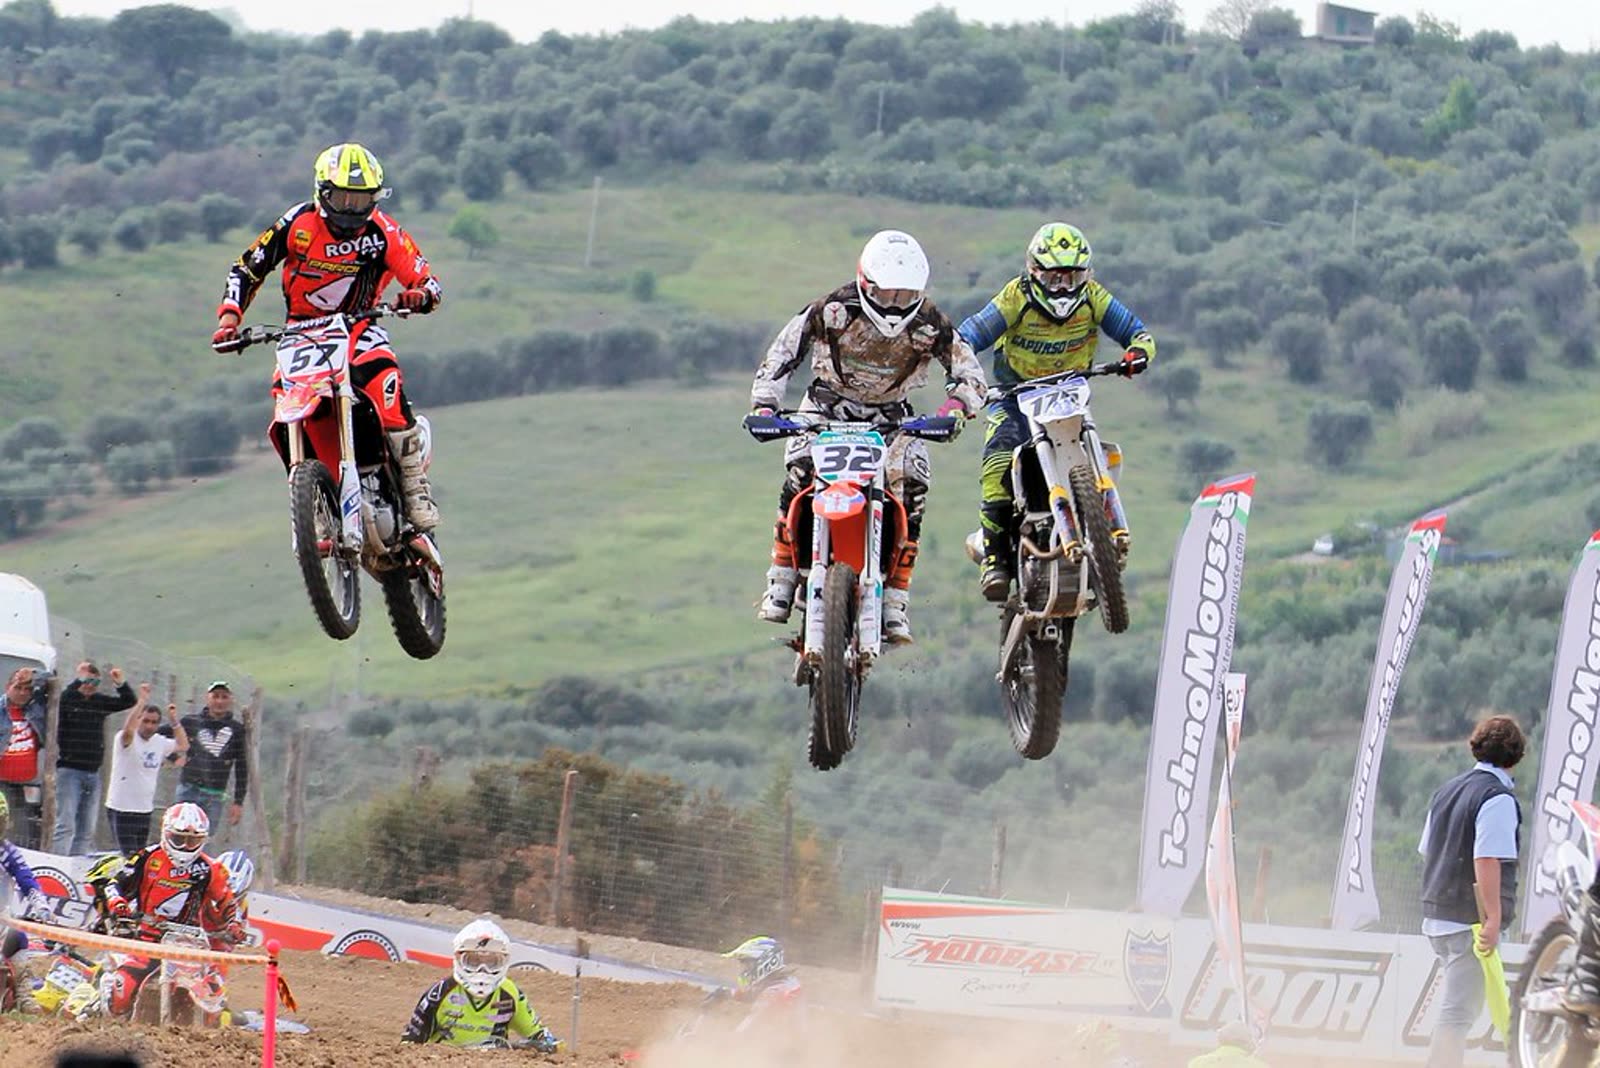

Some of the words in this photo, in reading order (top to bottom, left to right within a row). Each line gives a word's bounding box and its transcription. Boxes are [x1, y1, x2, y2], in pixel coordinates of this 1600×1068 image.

[325, 233, 385, 257] ROYAL
[289, 343, 339, 374] 57
[1011, 334, 1068, 355] CAPURSO
[818, 445, 882, 474] 32
[1159, 490, 1238, 868] TechnoMousse
